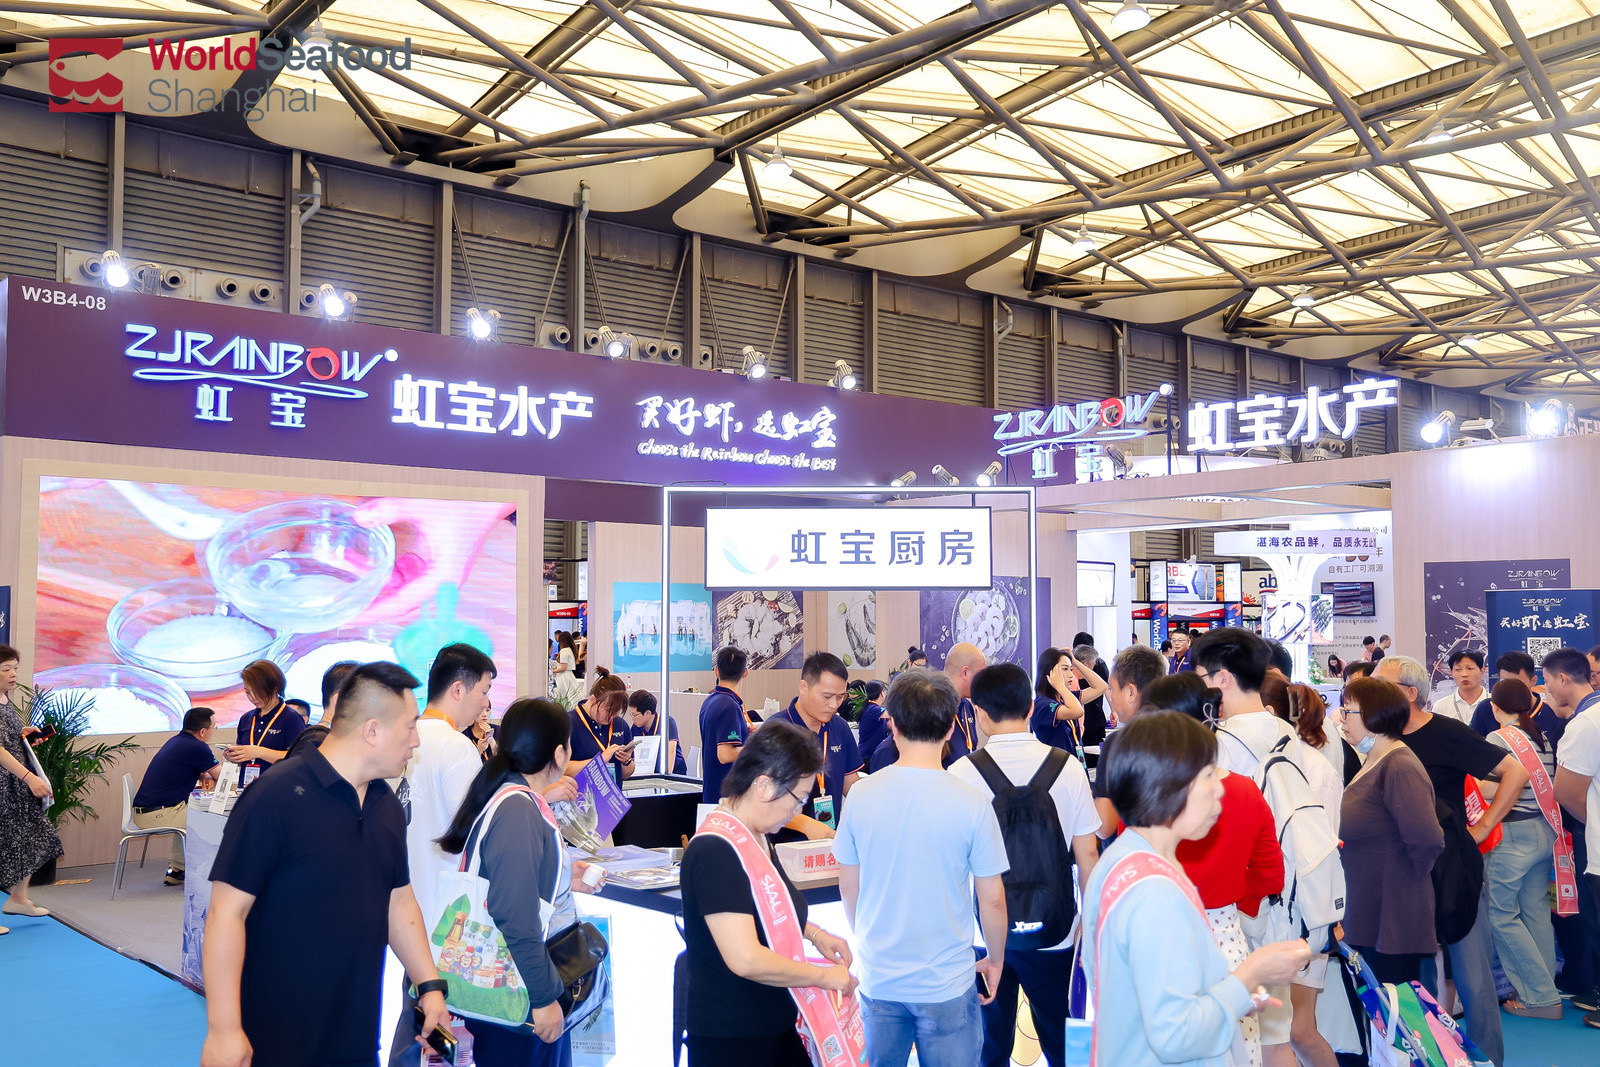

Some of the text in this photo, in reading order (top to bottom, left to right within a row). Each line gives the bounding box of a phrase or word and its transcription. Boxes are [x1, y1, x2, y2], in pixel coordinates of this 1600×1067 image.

[21, 285, 106, 311] W3B4-08
[194, 384, 307, 428] 虹宝
[391, 373, 594, 440] 虹宝水产
[1187, 377, 1399, 452] 虹宝水产
[637, 438, 837, 472] Choose the Rainbow Choose the Best
[1031, 443, 1104, 479] 虹宝
[790, 529, 976, 566] 虹宝厨房
[587, 759, 612, 798] RAINBOW
[804, 852, 840, 868] 请赐名
[760, 874, 782, 914] SIAL
